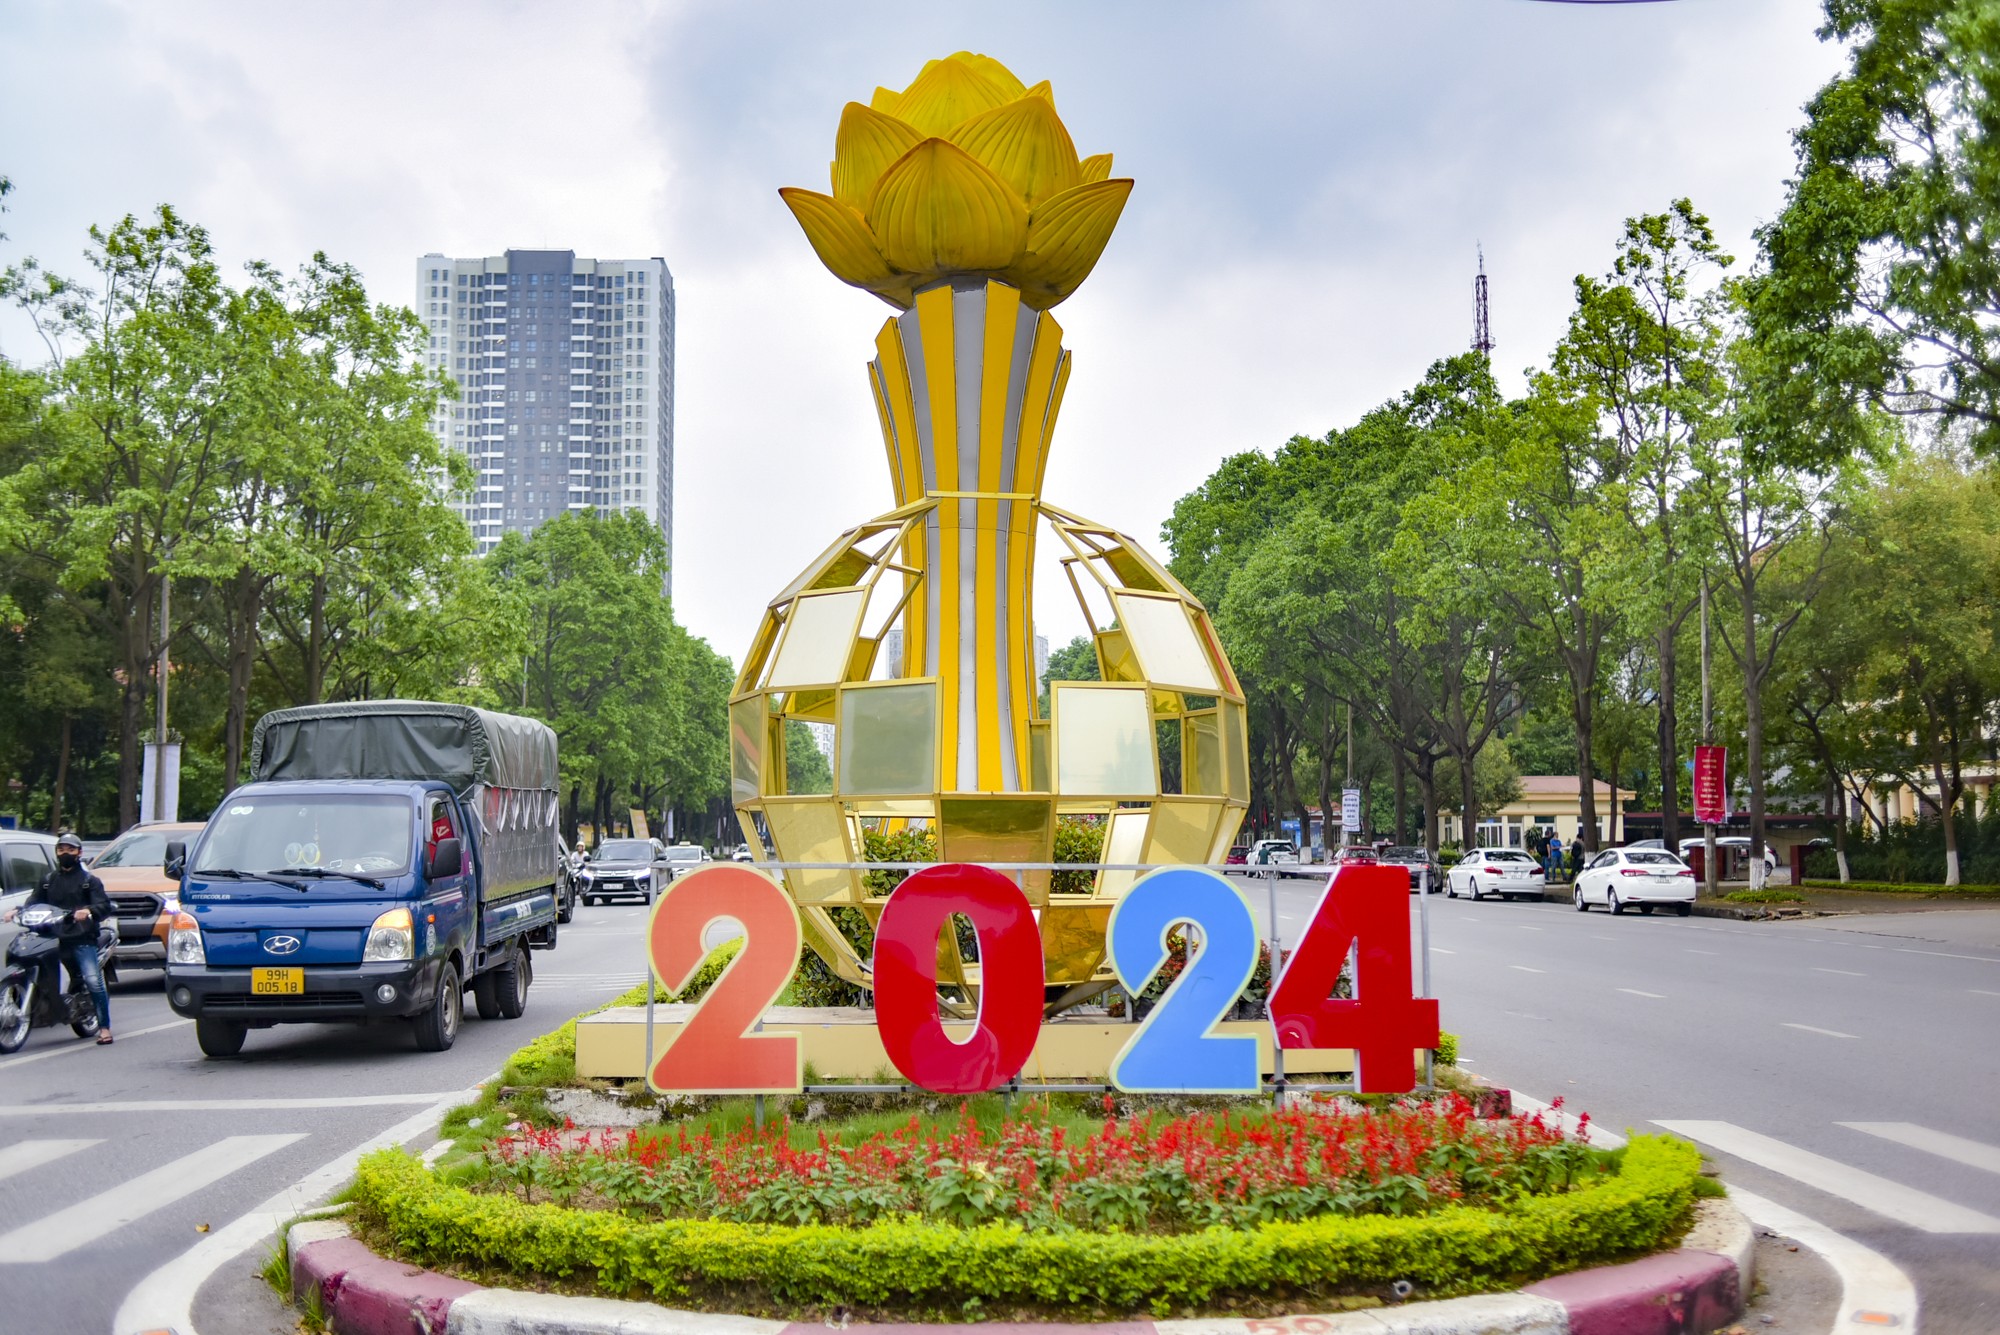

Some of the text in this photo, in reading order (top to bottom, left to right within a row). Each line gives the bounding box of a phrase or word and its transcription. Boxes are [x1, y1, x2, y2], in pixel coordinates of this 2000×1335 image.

[266, 969, 289, 981] 99H
[647, 863, 1440, 1095] 2024
[256, 981, 298, 993] 005.18
